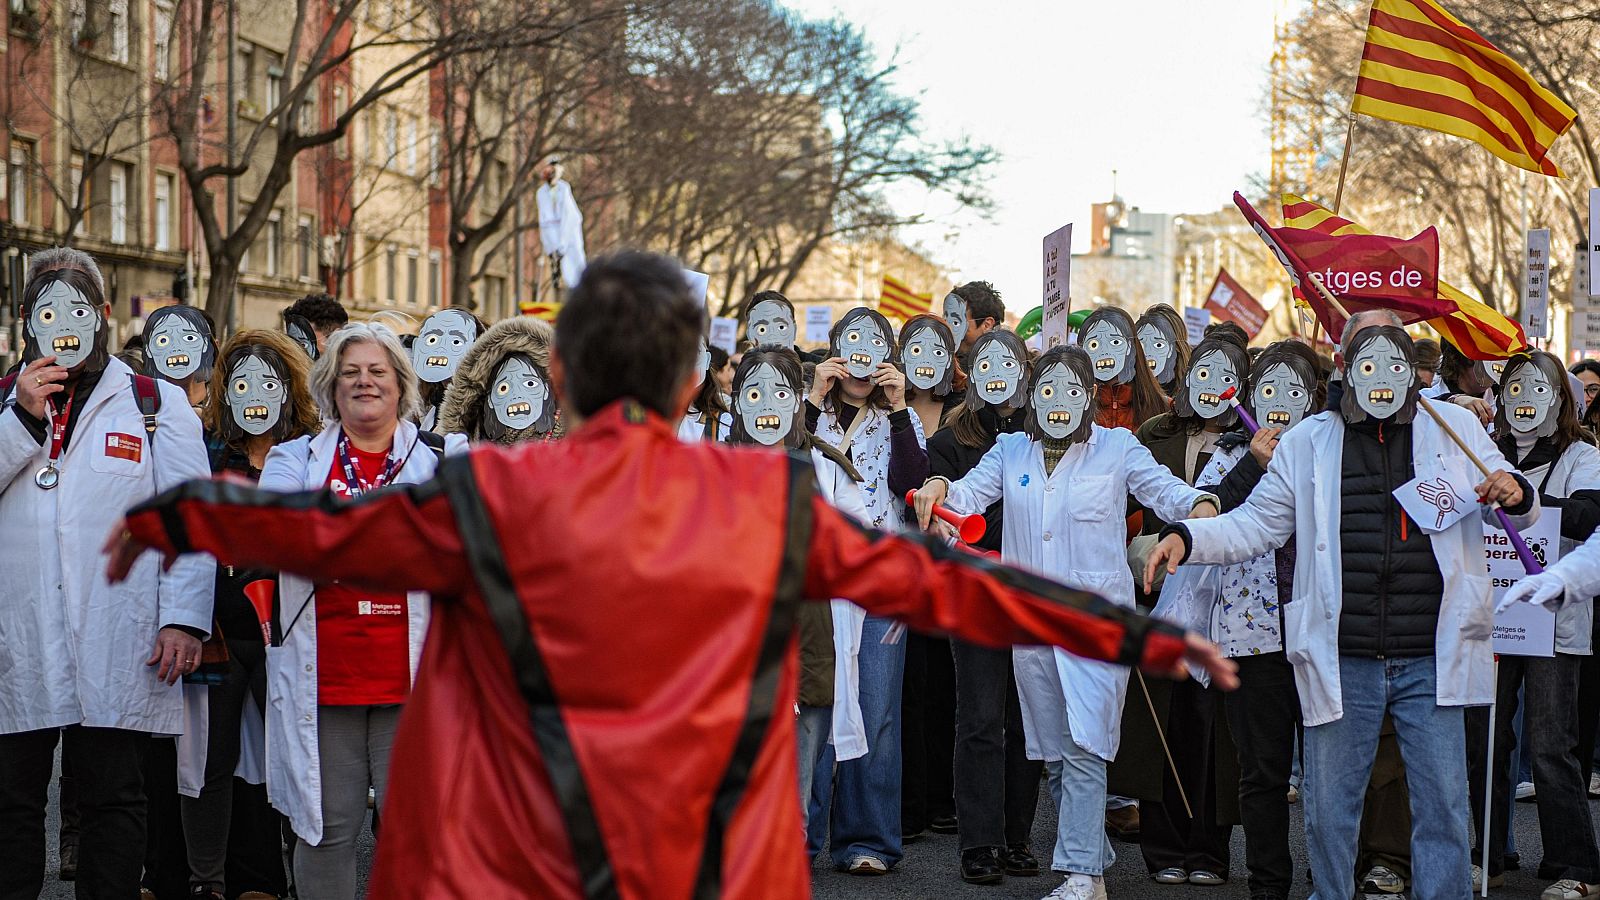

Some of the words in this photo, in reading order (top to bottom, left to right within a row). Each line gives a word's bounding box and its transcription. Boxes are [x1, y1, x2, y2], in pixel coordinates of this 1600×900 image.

[1311, 267, 1382, 294] etges
[1389, 265, 1422, 288] de
[1483, 533, 1508, 546] nta
[1492, 625, 1517, 634] Metges
[1491, 632, 1526, 642] Catalunya
